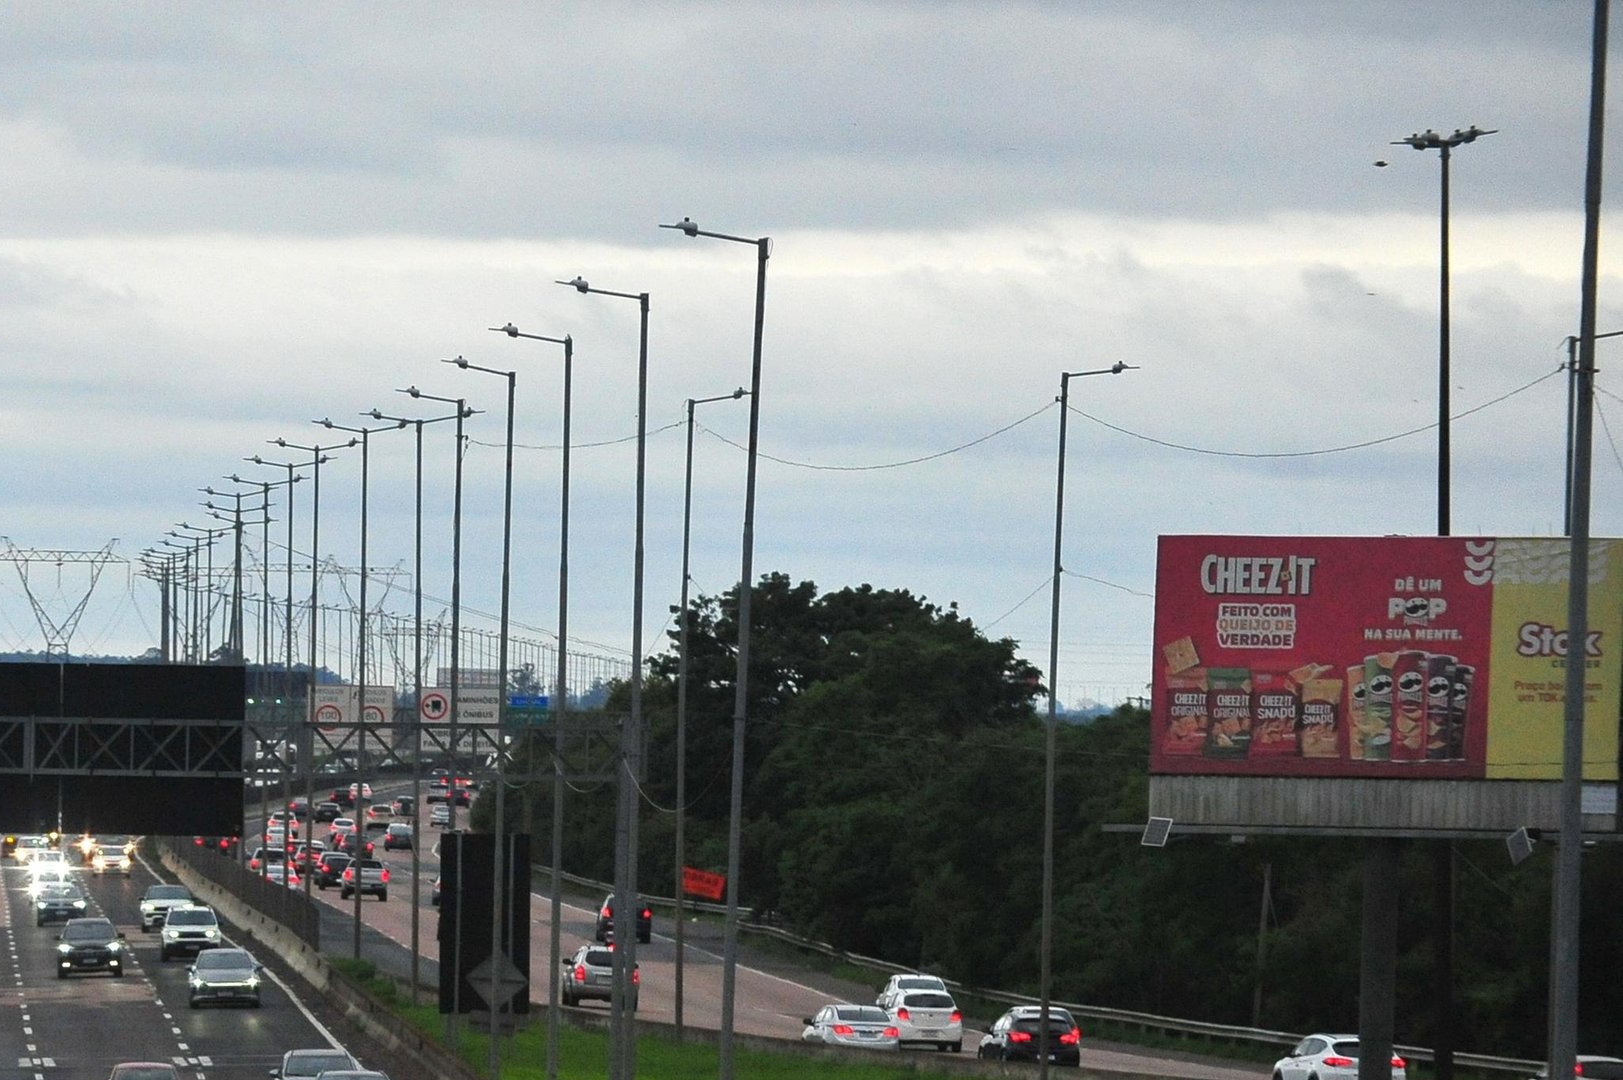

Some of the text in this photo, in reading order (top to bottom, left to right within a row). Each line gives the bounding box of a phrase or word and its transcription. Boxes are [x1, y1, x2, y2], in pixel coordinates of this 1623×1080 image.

[1395, 576, 1442, 592] DÊ UM
[1221, 605, 1292, 618] FEITO COM
[1219, 618, 1294, 632] QUEIJO DE
[1219, 633, 1292, 646] VERDADE
[1364, 629, 1463, 640] NA SUA MENTE.
[457, 696, 498, 704] AMINHÕES
[321, 711, 337, 720] 100
[365, 711, 378, 721] 80
[463, 710, 494, 718] ÔNIBUS
